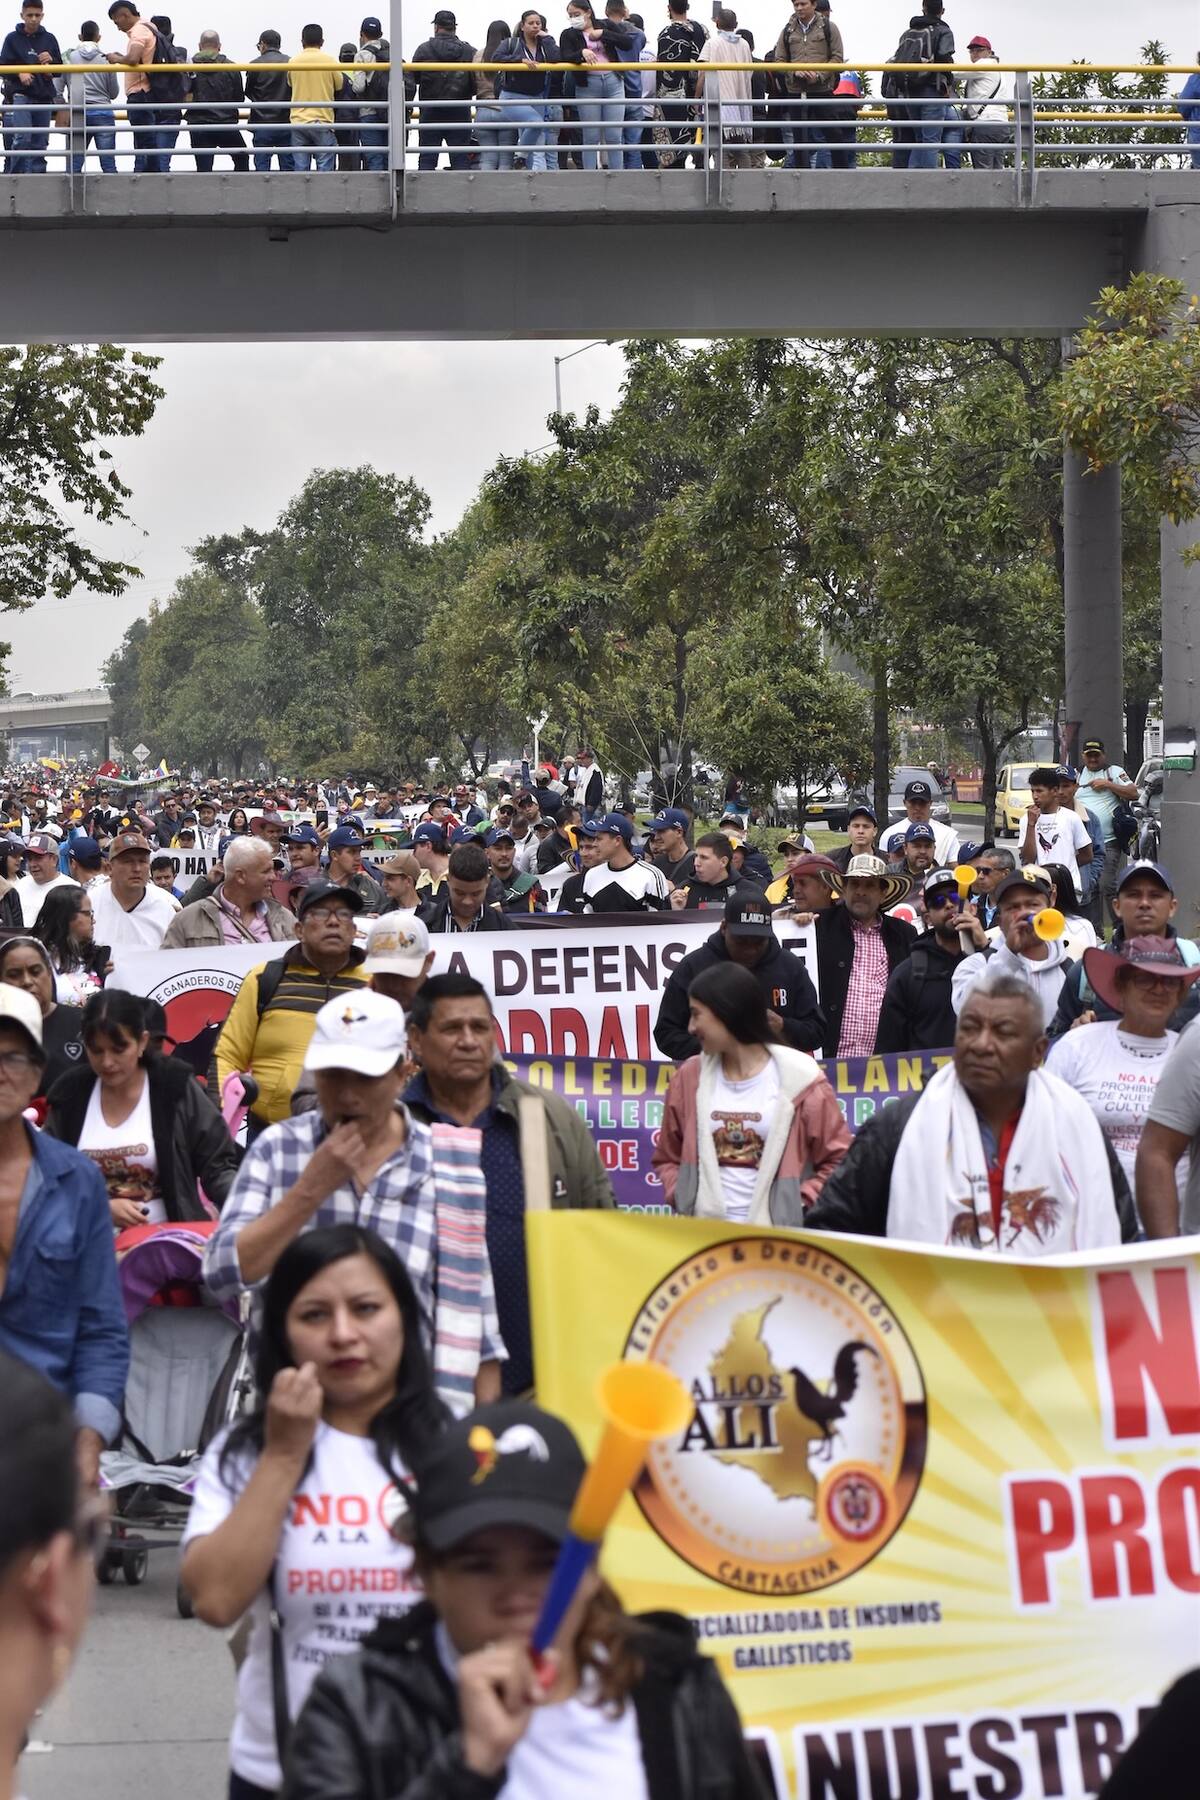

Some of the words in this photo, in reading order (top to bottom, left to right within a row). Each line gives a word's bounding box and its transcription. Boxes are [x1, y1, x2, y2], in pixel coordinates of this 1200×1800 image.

[185, 857, 207, 875] HA
[163, 976, 225, 997] GANADEROS
[772, 988, 788, 1007] PB
[819, 1055, 954, 1094] LÁNT
[1118, 1073, 1136, 1082] NO
[1139, 1075, 1147, 1084] A
[1098, 1092, 1116, 1101] DE
[597, 1139, 640, 1172] DE
[760, 1243, 895, 1335] Dedicación
[291, 1495, 369, 1527] NO
[313, 1530, 328, 1544] A
[339, 1530, 369, 1544] LA
[718, 1559, 841, 1590] CARTAGENA
[828, 1606, 850, 1630] DE
[855, 1600, 942, 1628] INSUMOS
[733, 1640, 853, 1670] GALLISTICOS
[803, 1705, 1160, 1800] NUESTR
